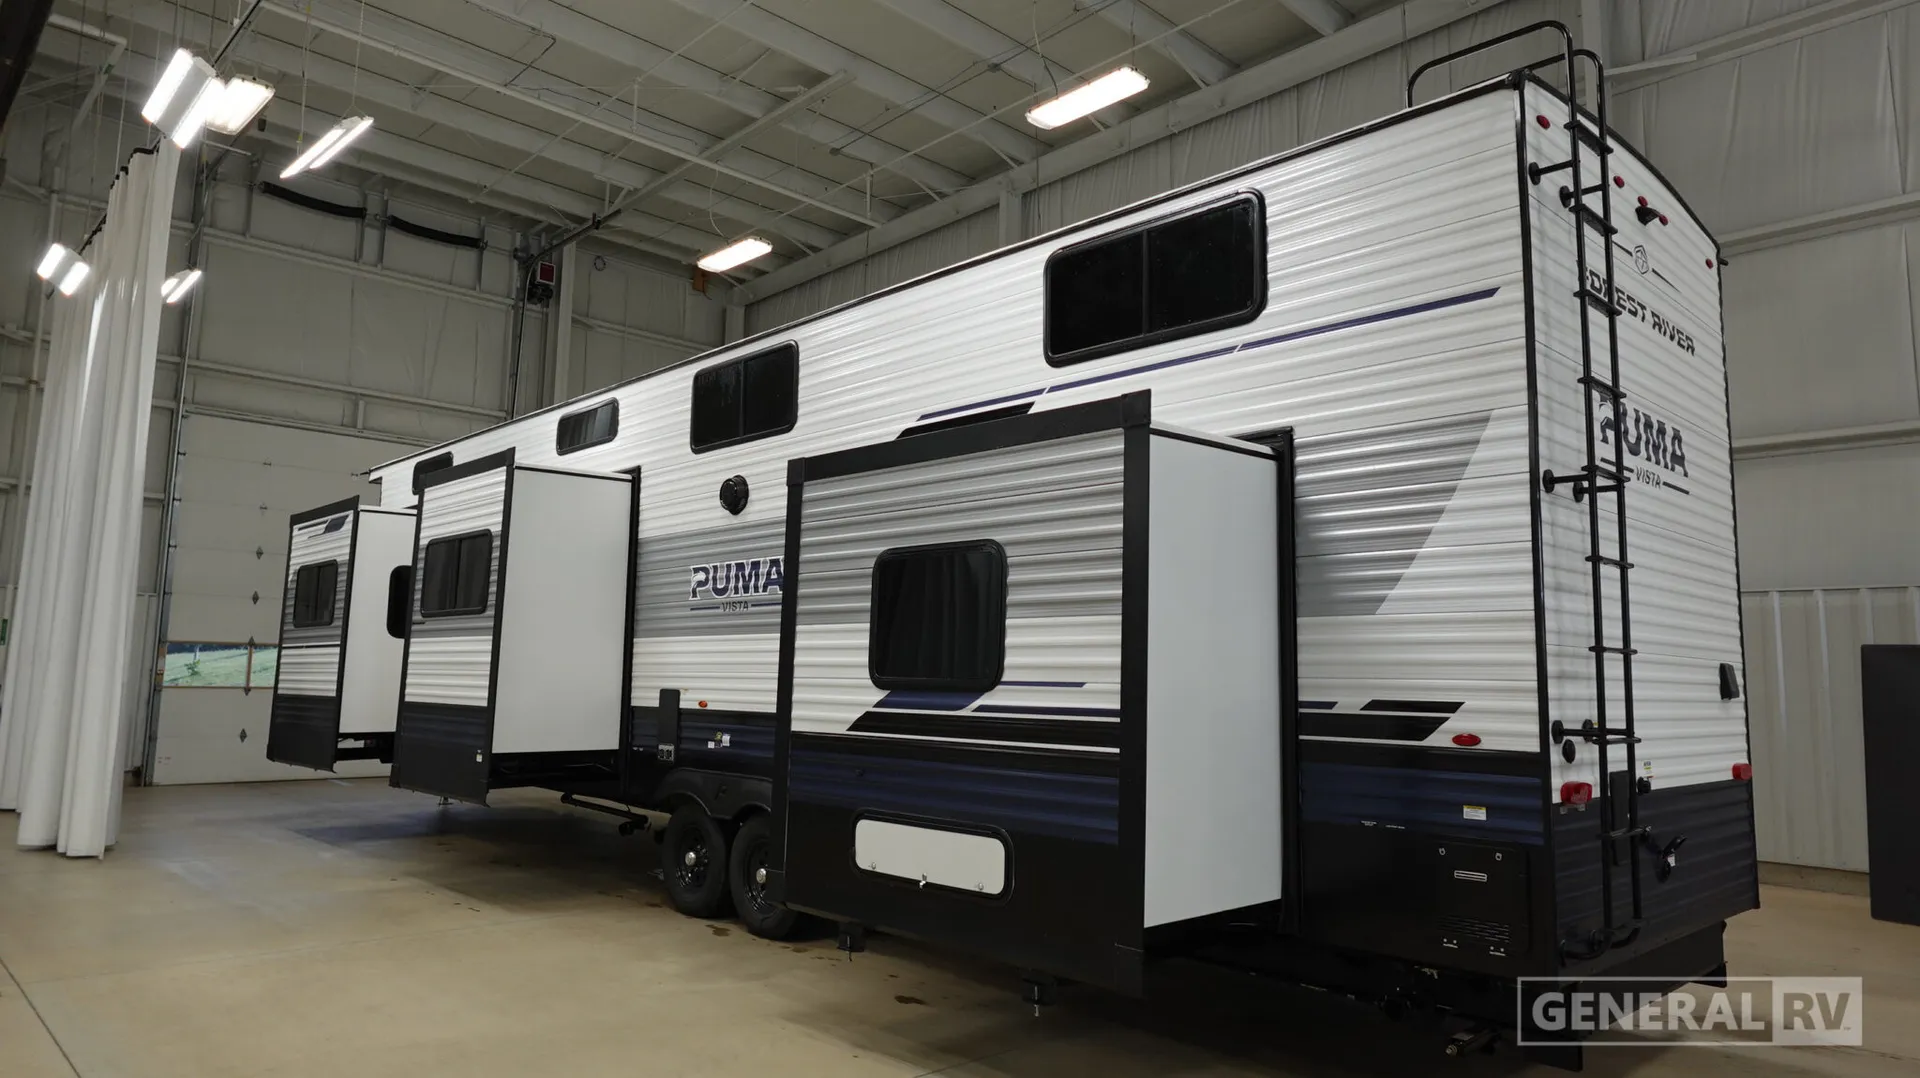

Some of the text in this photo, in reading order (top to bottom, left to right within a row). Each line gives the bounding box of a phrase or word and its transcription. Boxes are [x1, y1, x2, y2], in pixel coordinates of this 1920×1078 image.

[1651, 310, 1695, 356] RIVER
[1636, 466, 1662, 489] VISTA
[689, 556, 784, 600] PUMA
[721, 600, 749, 612] VISTA
